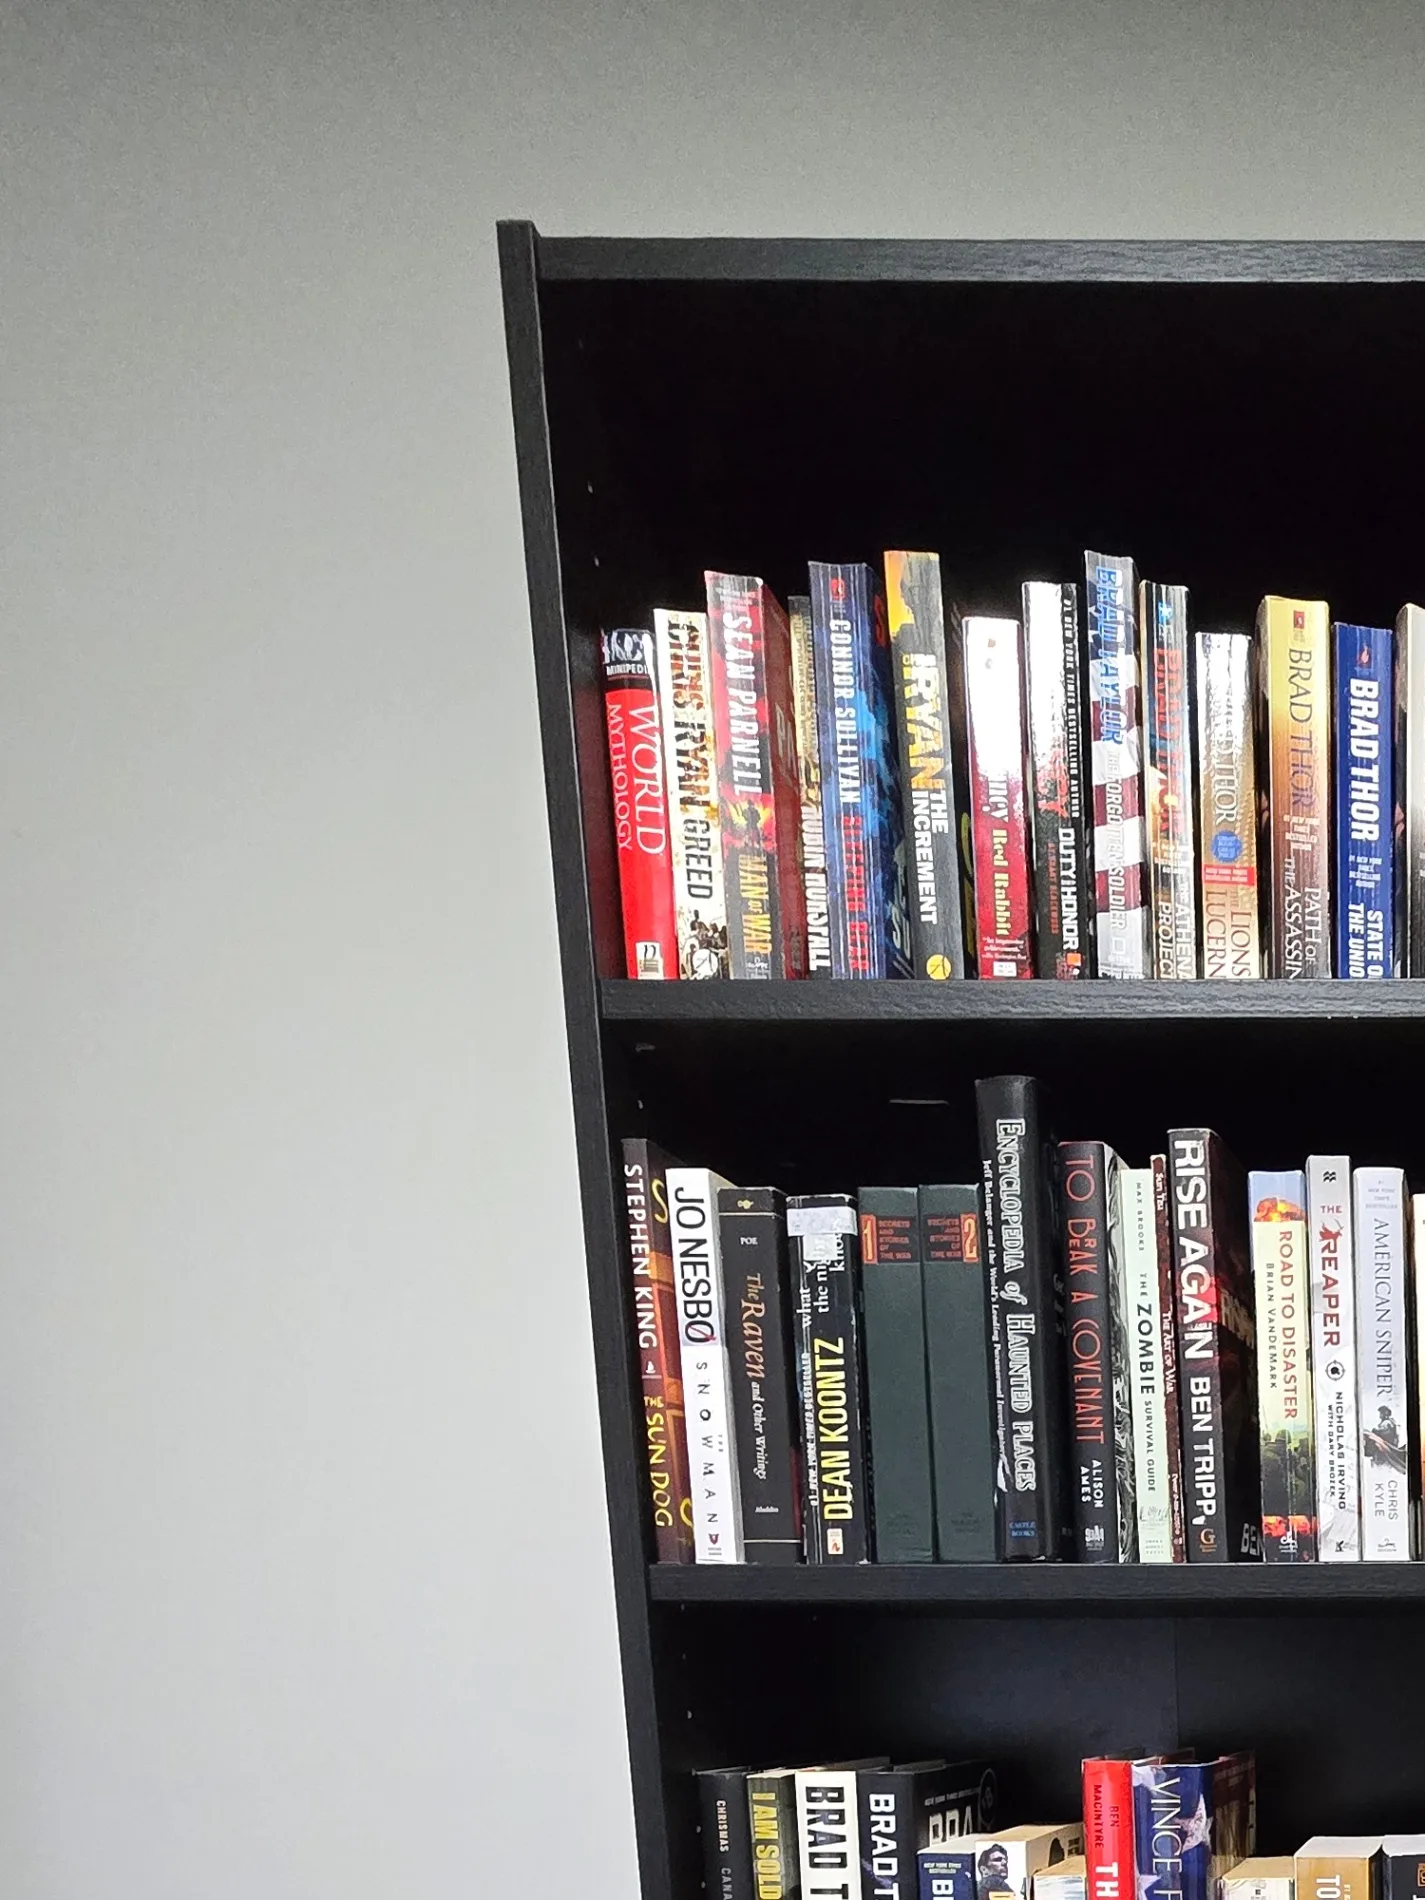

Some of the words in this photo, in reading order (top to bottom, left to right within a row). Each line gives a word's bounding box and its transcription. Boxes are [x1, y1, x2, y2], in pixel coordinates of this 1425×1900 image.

[1289, 648, 1313, 723] BRAD
[1349, 678, 1379, 759] BRAD
[631, 705, 665, 854] WORLD
[1291, 731, 1313, 809] THOR
[1350, 760, 1379, 840] THOR
[928, 791, 947, 834] THE
[910, 791, 937, 924] INCREMENT
[740, 1237, 758, 1245] POE
[1136, 1212, 1145, 1251] BROOKS
[1320, 1205, 1342, 1213] THE
[624, 1164, 650, 1275] STEPHEN
[638, 1286, 657, 1349] KING
[1137, 1304, 1155, 1394] ZOMBIE
[814, 1337, 847, 1442] KOONTZ
[1145, 1400, 1154, 1454] SURVIVAL
[823, 1451, 853, 1520] DEAN
[1081, 1466, 1091, 1503] AMES
[1092, 1459, 1103, 1508] ALISON
[1147, 1460, 1156, 1492] GUIDE
[805, 1785, 847, 1870] BRAD
[868, 1792, 897, 1886] BRAD
[1093, 1784, 1103, 1849] MACINTYRE
[1109, 1805, 1119, 1827] BEN
[1151, 1777, 1182, 1874] VINCE
